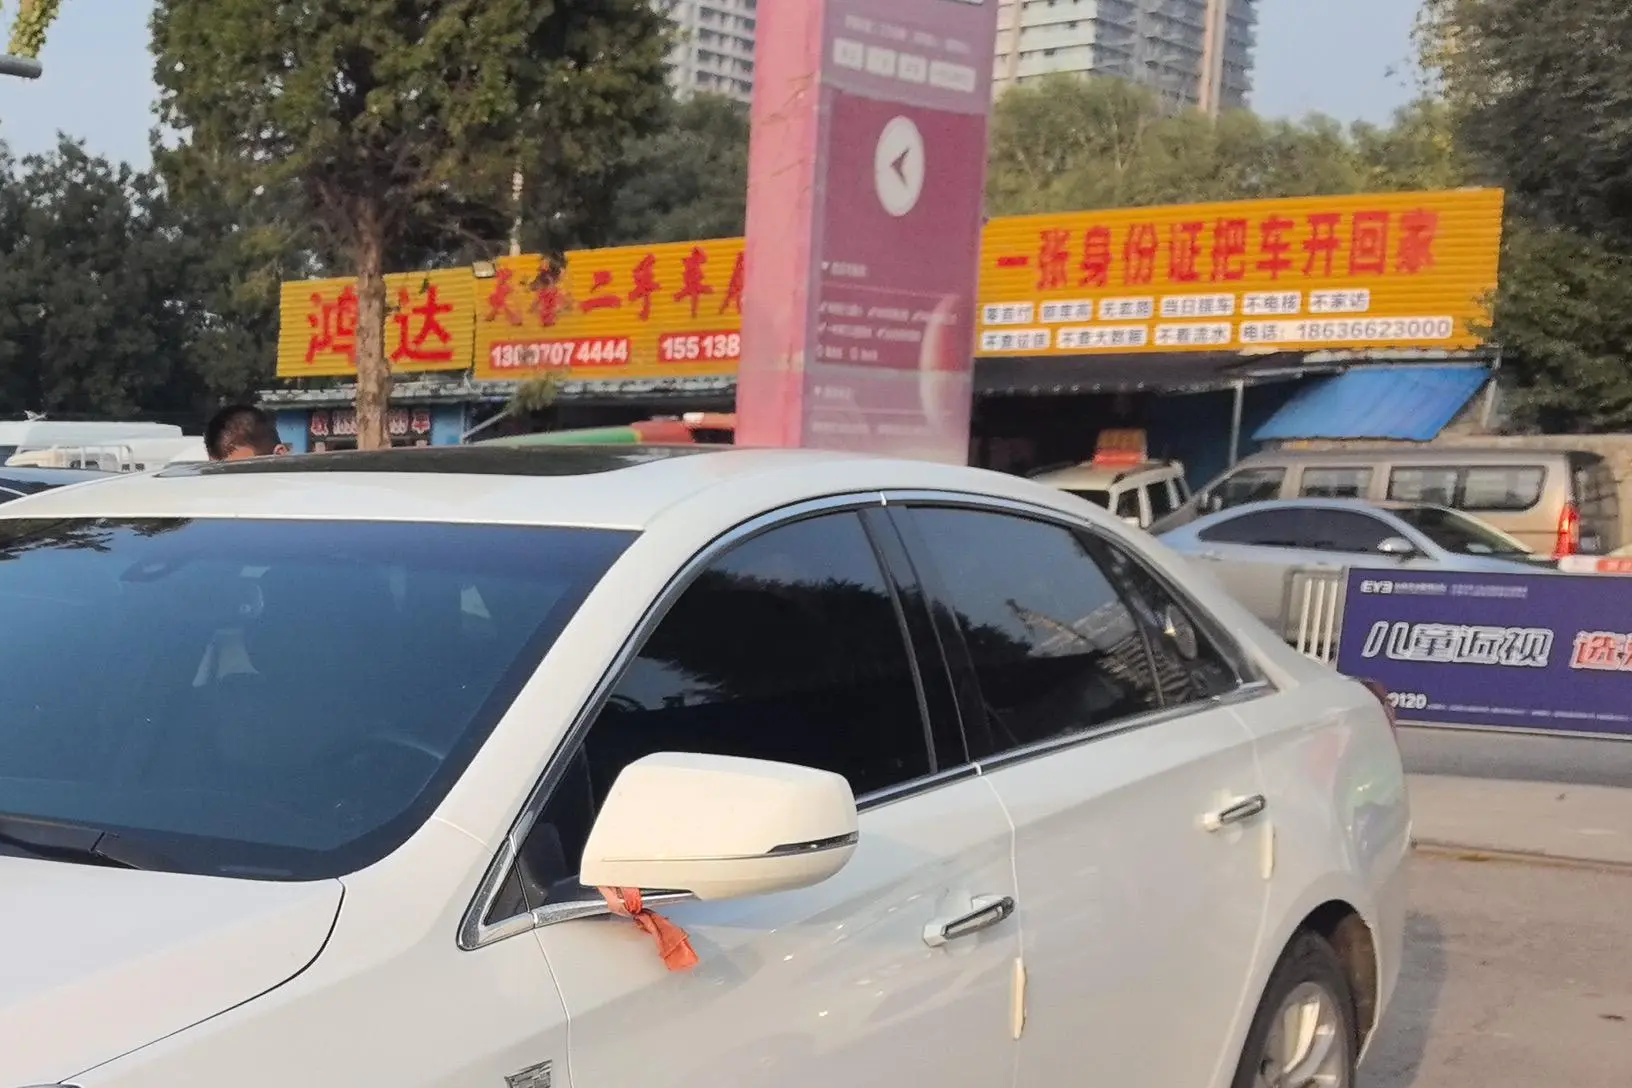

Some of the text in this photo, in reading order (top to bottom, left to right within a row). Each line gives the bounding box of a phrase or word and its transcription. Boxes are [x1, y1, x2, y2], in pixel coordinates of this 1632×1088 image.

[996, 208, 1439, 291] 一张身份证把车开回家
